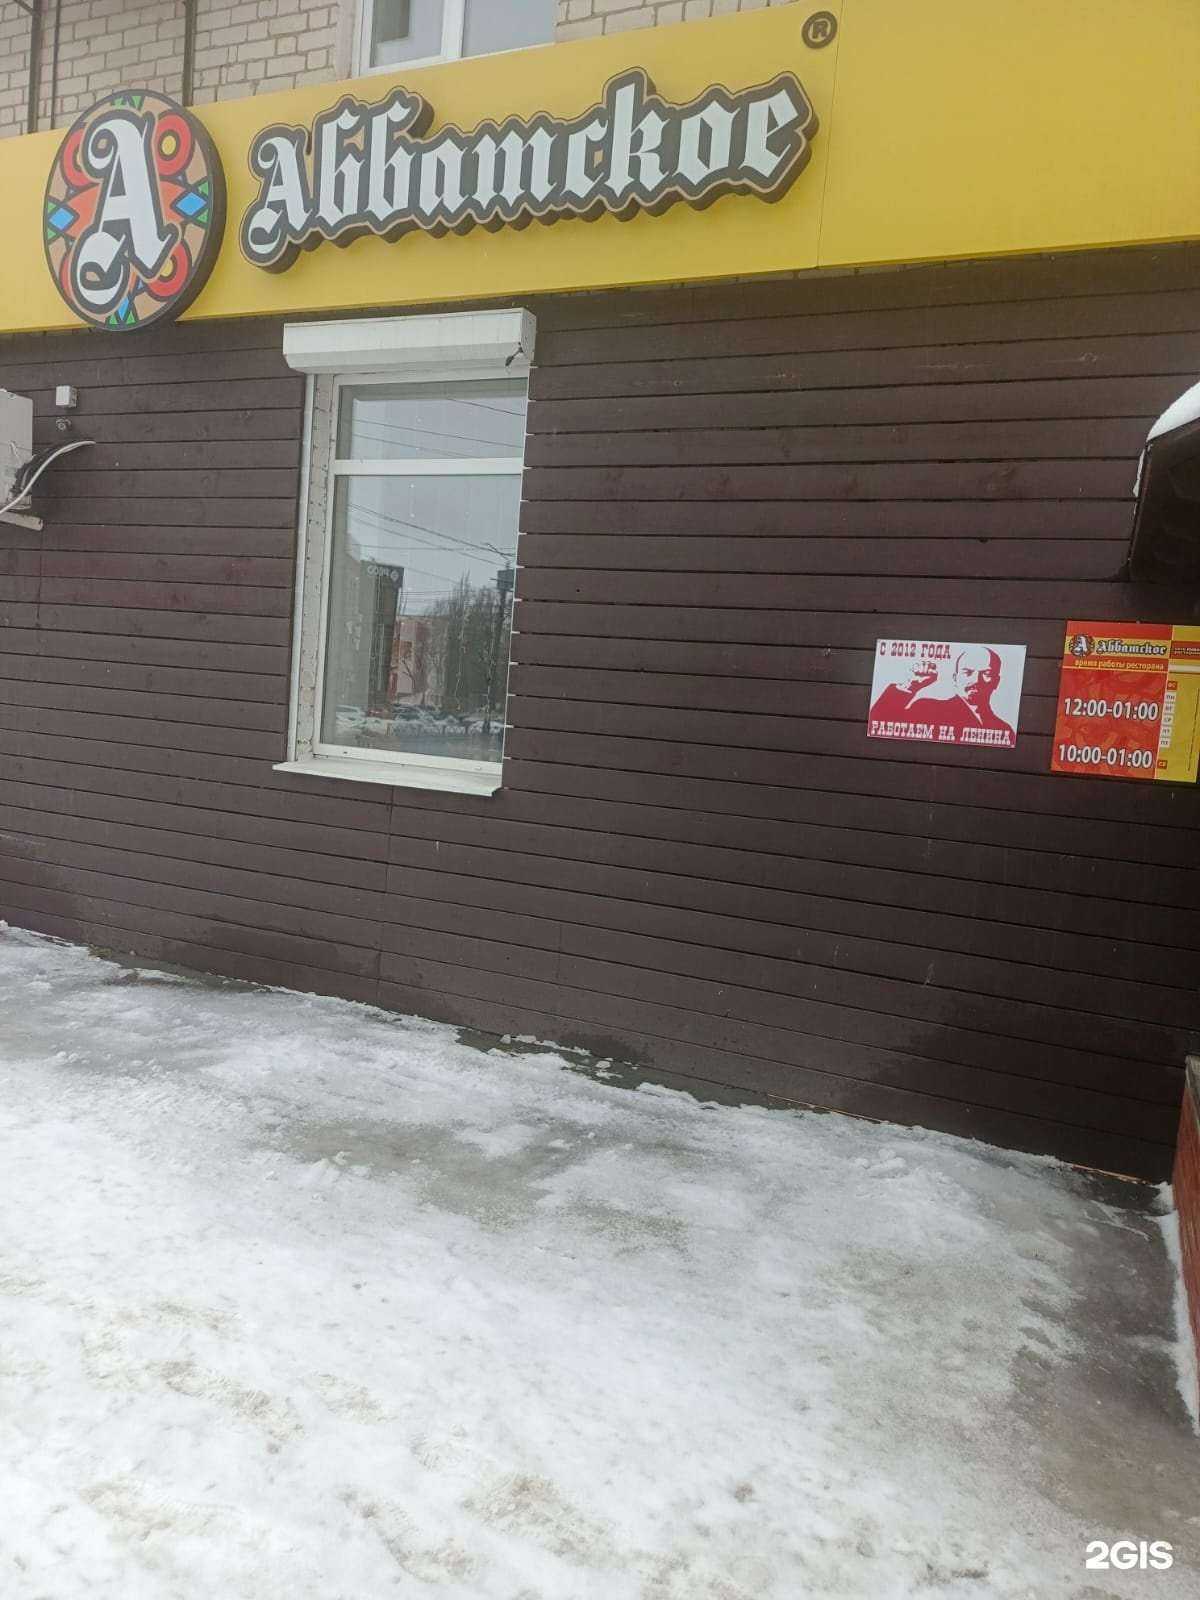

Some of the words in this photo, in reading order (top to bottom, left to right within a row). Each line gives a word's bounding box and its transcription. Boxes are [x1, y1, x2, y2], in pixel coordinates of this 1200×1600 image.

[879, 641, 887, 656] С
[890, 641, 916, 658] 2012
[920, 643, 951, 660] ГОДА
[1099, 660, 1125, 669] работы
[1126, 662, 1163, 671] ресторана
[1064, 698, 1159, 721] 12:00-01:00
[871, 720, 934, 740] РАБОТАЕМ
[938, 725, 955, 741] НА
[960, 727, 1011, 745] ЛЕНИНА
[1059, 744, 1153, 768] 10:00-01:00
